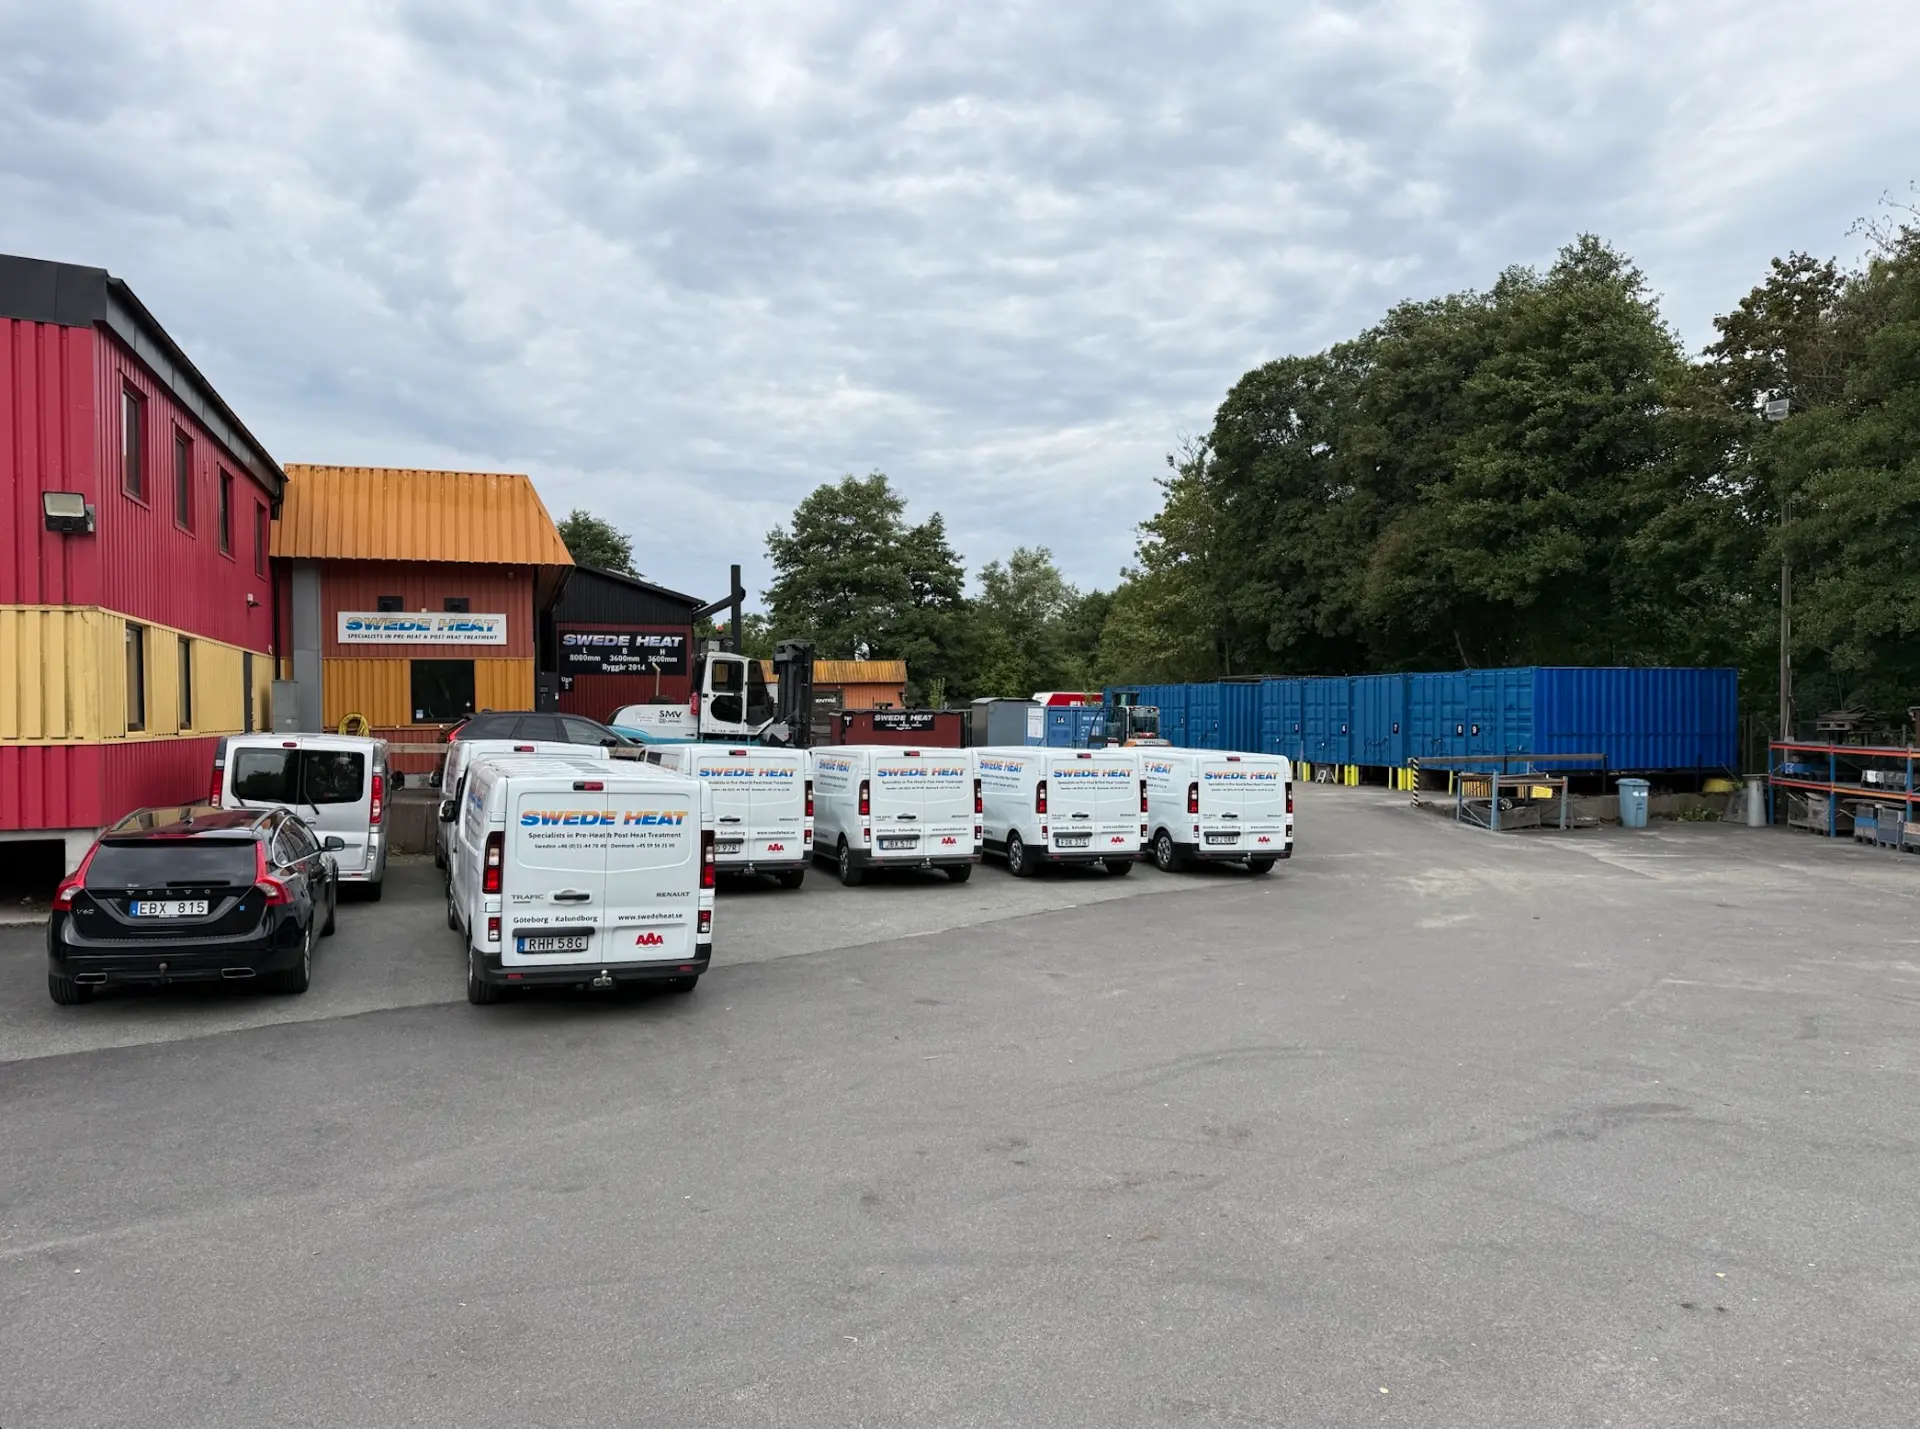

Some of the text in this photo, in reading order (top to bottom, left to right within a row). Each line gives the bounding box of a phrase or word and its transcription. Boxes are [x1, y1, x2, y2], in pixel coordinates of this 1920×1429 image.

[346, 617, 499, 632] SWEDE HEAT
[562, 634, 683, 647] SWEDE HEAT
[602, 663, 627, 672] Byggår
[836, 760, 852, 772] HEAT
[980, 760, 1024, 772] SWEDE HEAT
[1150, 762, 1173, 774] HEAT
[699, 768, 797, 777] SWEDE HEAT
[877, 768, 966, 777] SWEDE HEAT
[1054, 768, 1133, 778] SWEDE HEAT
[1204, 772, 1279, 780] SWEDE HEAT
[520, 810, 688, 826] SWEDE HEAT
[140, 902, 205, 914] EBX 815
[513, 916, 549, 924] Göteborg
[618, 912, 683, 920] www.swedeheat.se
[528, 936, 582, 950] RHH 58G
